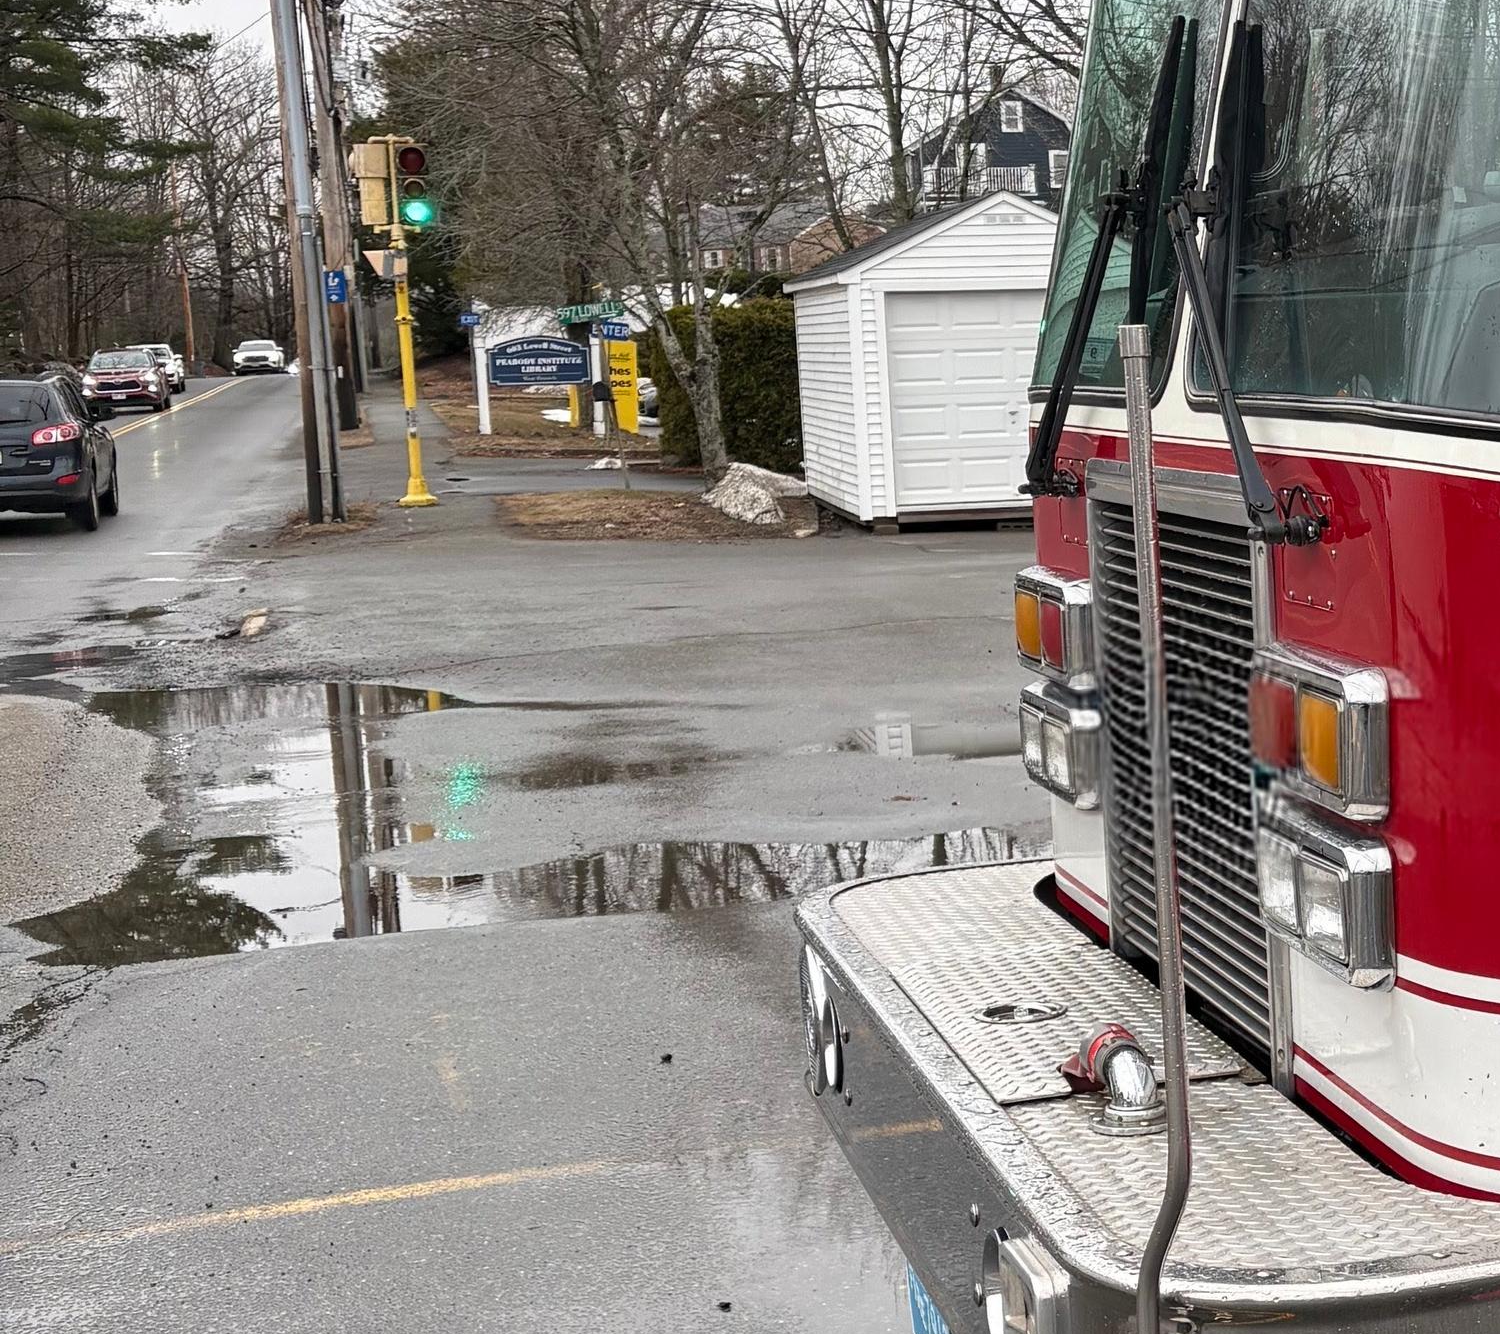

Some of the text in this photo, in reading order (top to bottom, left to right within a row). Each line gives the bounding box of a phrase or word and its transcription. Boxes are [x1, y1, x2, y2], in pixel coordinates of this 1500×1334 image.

[557, 306, 577, 320] 597
[578, 302, 618, 316] LOWELL
[592, 323, 630, 337] ENTER
[523, 342, 549, 350] Lowell
[496, 358, 535, 366] PEABODY
[609, 366, 631, 375] hes
[611, 379, 632, 388] oes
